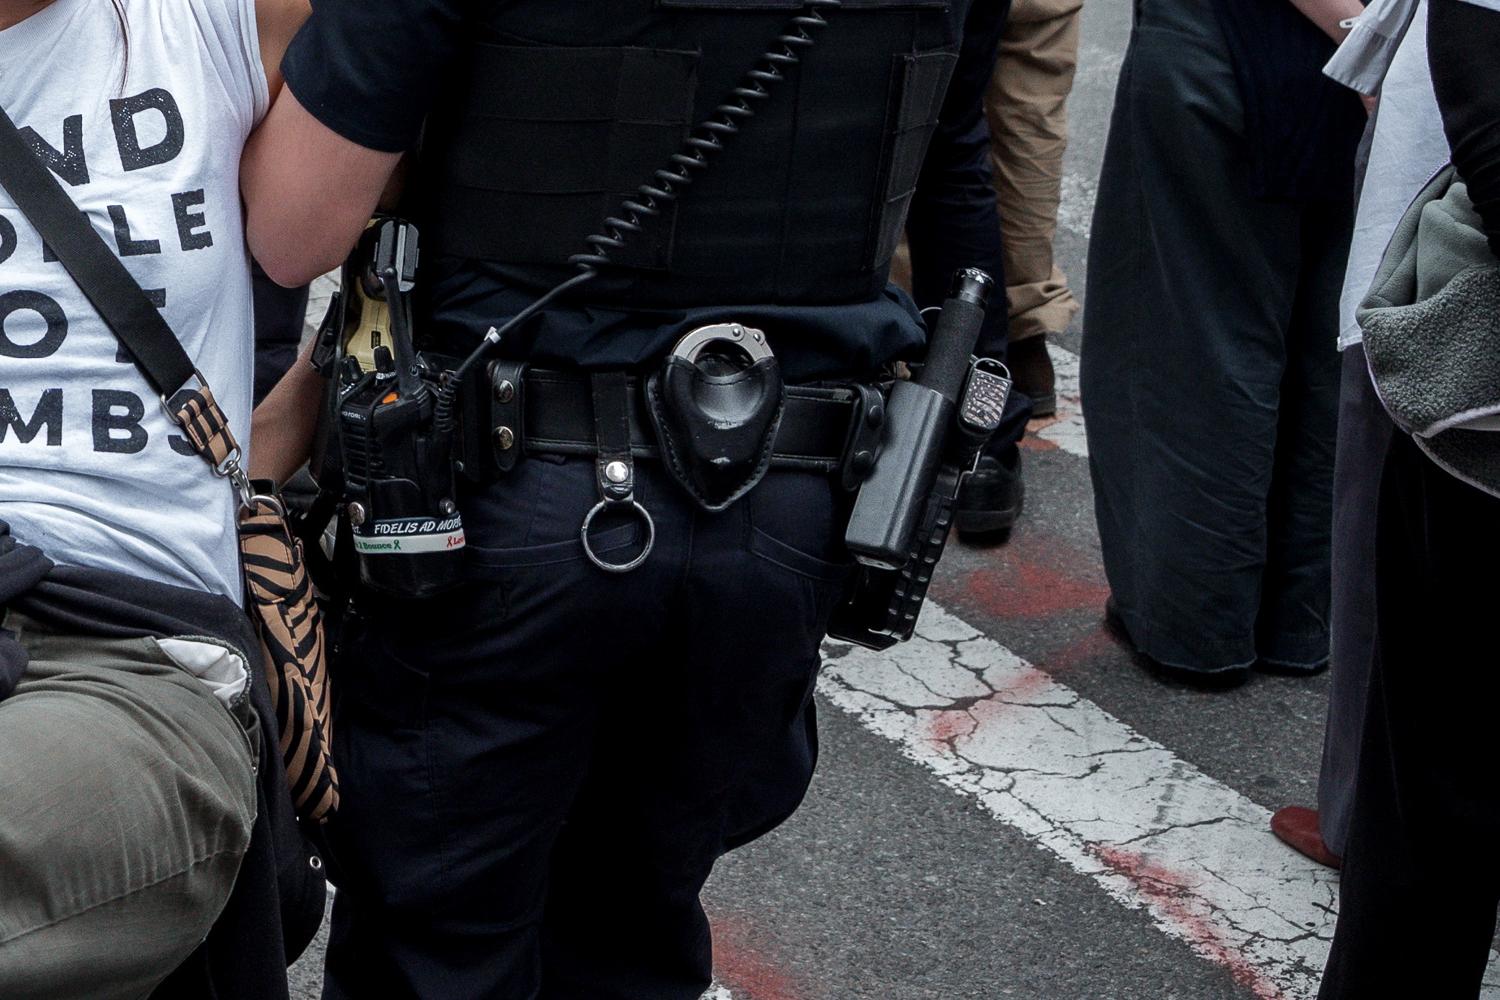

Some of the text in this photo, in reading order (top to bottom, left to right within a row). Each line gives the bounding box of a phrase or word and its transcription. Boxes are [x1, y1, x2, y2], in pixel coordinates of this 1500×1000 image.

[374, 522, 417, 535] FIDELIS
[418, 521, 436, 532] AD
[363, 542, 393, 550] Bounce
